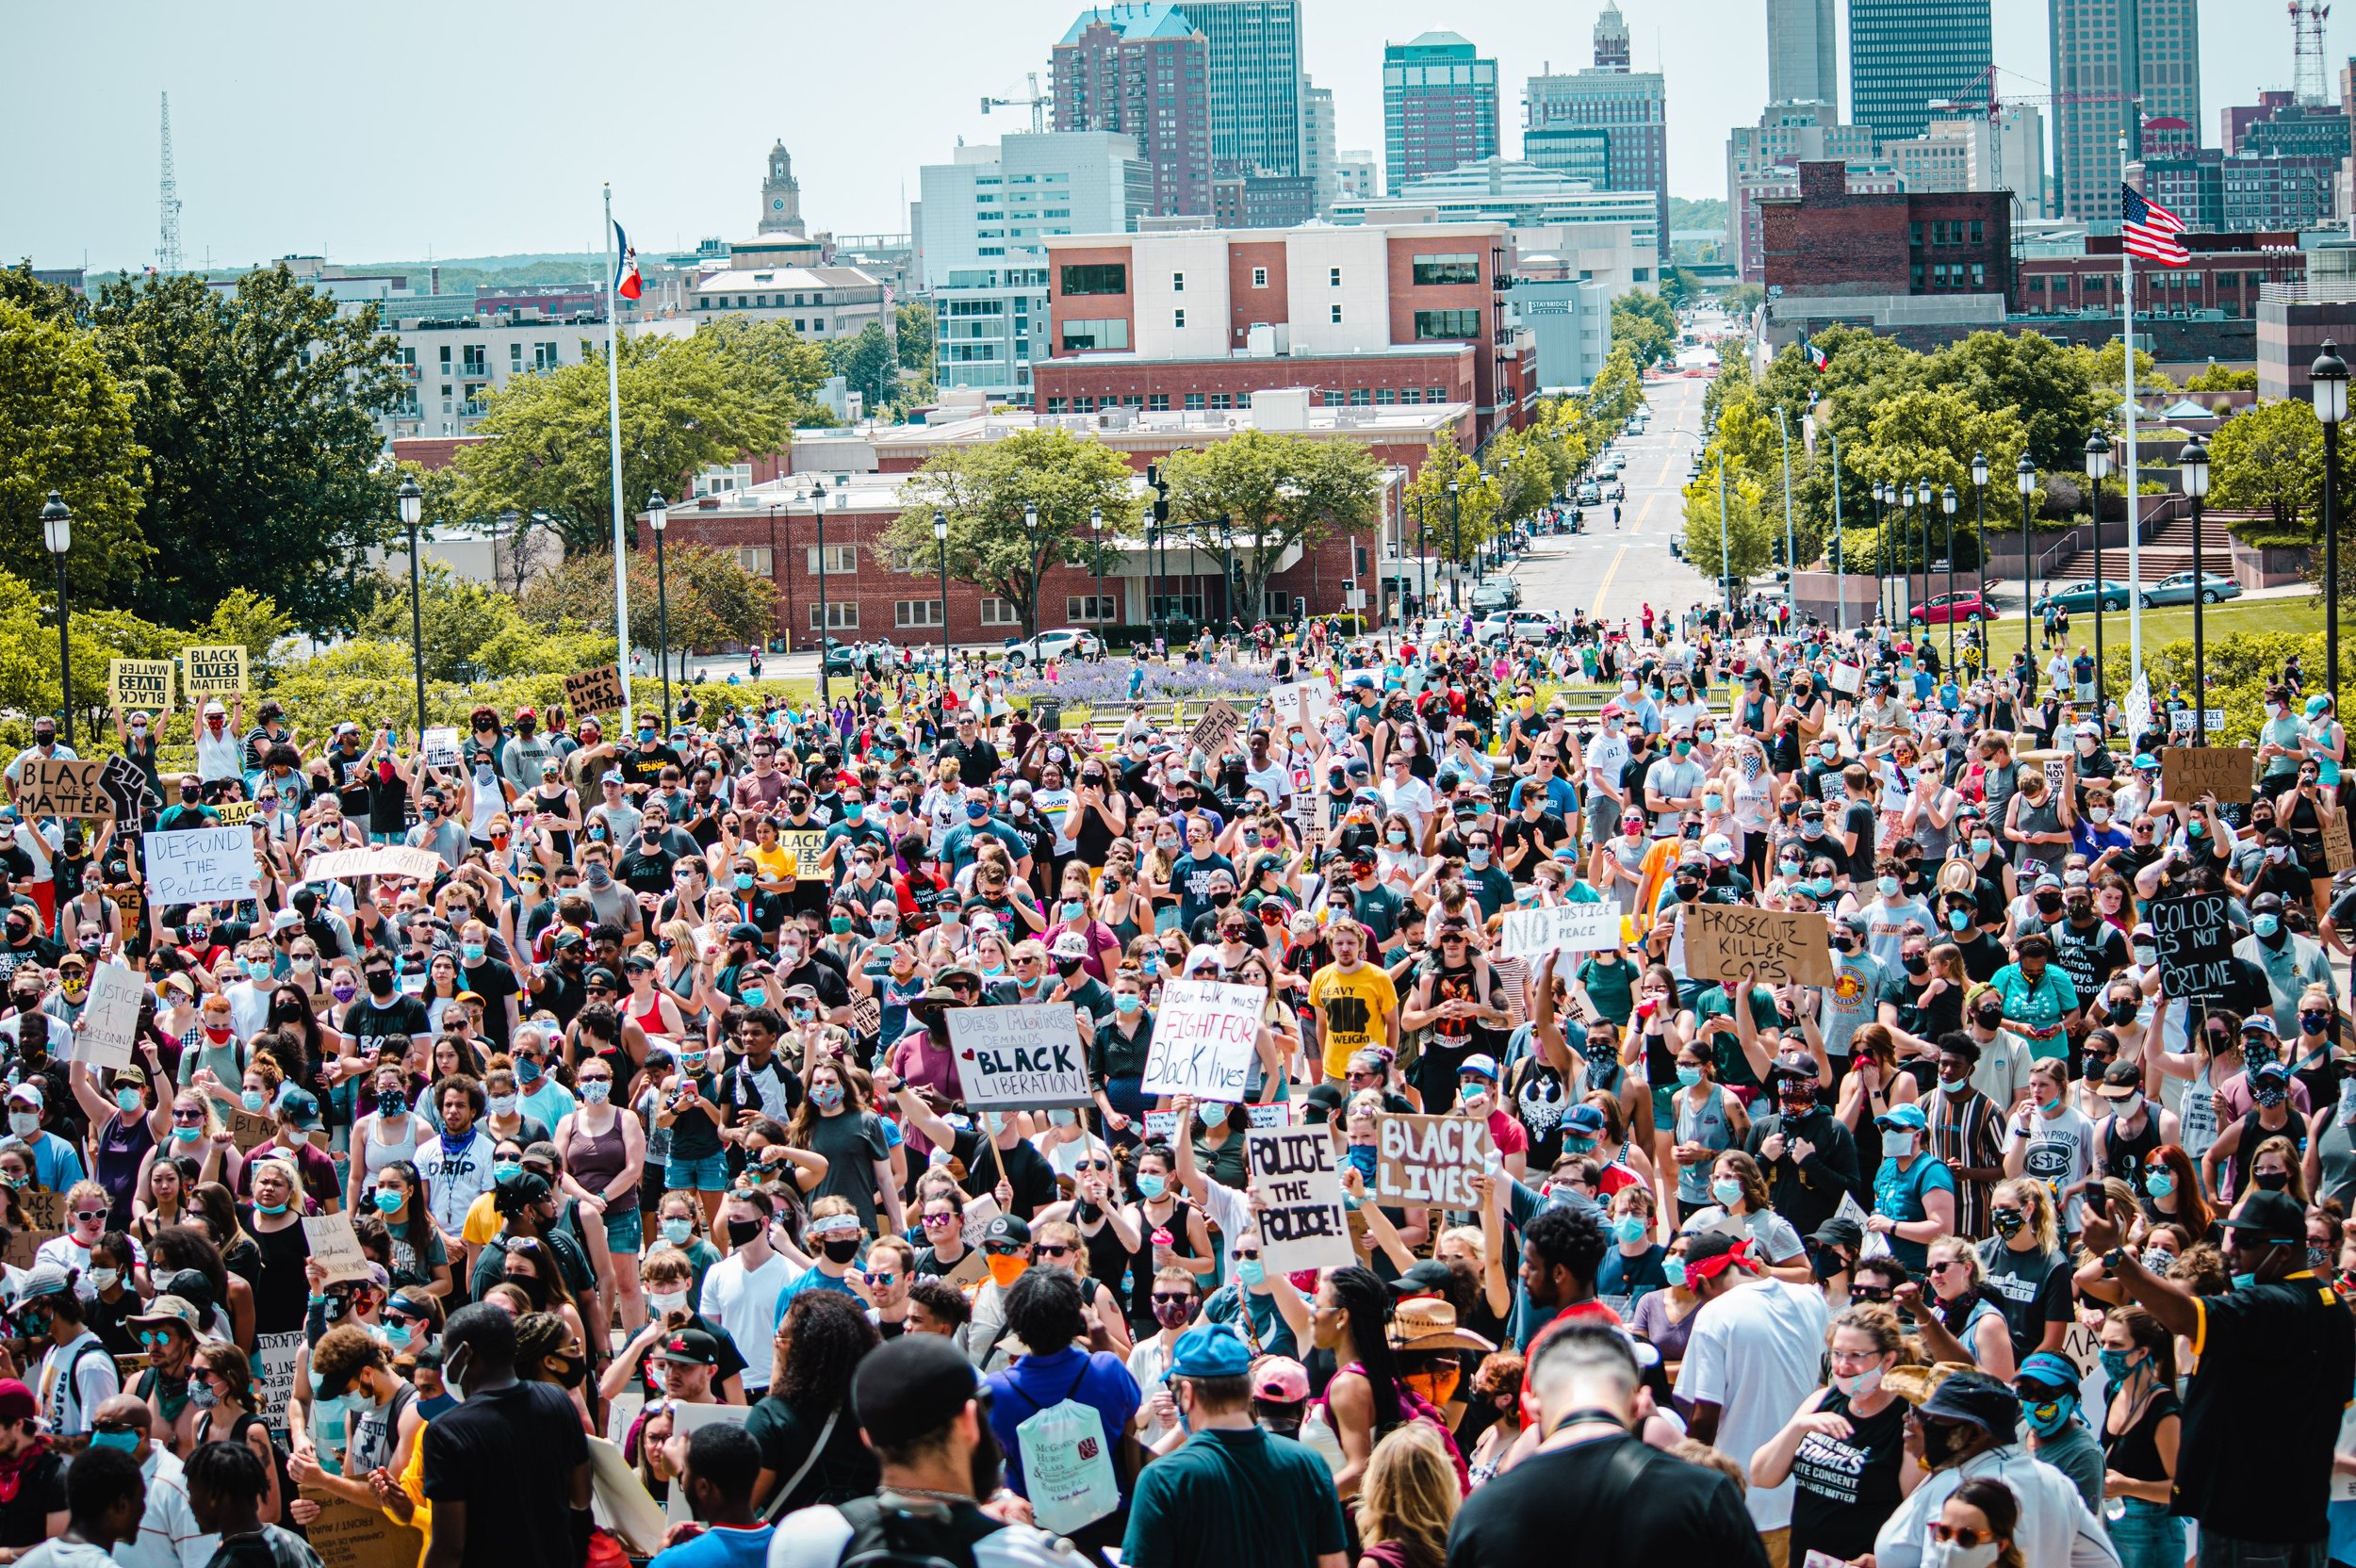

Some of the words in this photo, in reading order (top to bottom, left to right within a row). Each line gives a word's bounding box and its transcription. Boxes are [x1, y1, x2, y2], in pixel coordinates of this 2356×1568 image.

[191, 650, 237, 662] BLACK
[120, 663, 168, 675] MATTER
[193, 664, 237, 678] LIVES
[121, 677, 166, 690] LIVES
[190, 678, 238, 691] MATTER
[566, 669, 613, 693] BLACK
[119, 691, 166, 704] BLACK
[570, 683, 614, 706] LIVES
[574, 694, 627, 717] MATTER
[2190, 710, 2220, 720] JTICE
[427, 741, 446, 753] LIVES
[427, 751, 456, 766] MATTER
[2182, 750, 2239, 770] BLACK
[2179, 770, 2232, 785] LIVES
[42, 784, 92, 796] LIVES
[2174, 785, 2242, 800] MATTER
[20, 792, 110, 814] MATTER
[1297, 796, 1317, 811] BLACK
[117, 820, 139, 833] BLM
[155, 831, 243, 860] DEFUND
[2323, 835, 2348, 850] LIVES
[183, 859, 217, 874] THE
[309, 858, 324, 876] I
[378, 849, 436, 873] BREATHE
[2327, 853, 2354, 872] MATTER
[1191, 871, 1209, 879] THE
[1190, 886, 1210, 894] WAY
[1557, 905, 1611, 922] JUSTICE
[2152, 896, 2225, 934] COLOR
[1510, 913, 1550, 952] NO
[1559, 924, 1596, 939] PEACE
[1701, 908, 1808, 945] PROSECUTE
[1720, 940, 1797, 959] KILLER
[2154, 934, 2180, 956] IS
[2193, 927, 2221, 948] NOT
[0, 950, 37, 959] AMERICA
[2160, 956, 2174, 972] A
[1721, 960, 1786, 978] COPS
[2162, 960, 2235, 996] CRIME
[90, 982, 141, 1005] JUSTICE
[1164, 982, 1194, 1004] Brown
[1231, 994, 1263, 1014] must
[1319, 987, 1355, 997] HEAVY
[98, 1003, 111, 1026] 4
[854, 1001, 876, 1022] LIVES
[956, 1012, 999, 1034] DES
[1165, 1010, 1221, 1038] FIGHT
[1219, 1014, 1256, 1043] FOR
[79, 1025, 132, 1046] BREONNA
[983, 1033, 1043, 1047] DEMANDS
[1333, 1034, 1370, 1044] WEIGHT
[976, 1044, 1076, 1076] BLACK
[1208, 1046, 1245, 1088] lives
[974, 1069, 1088, 1098] LIBERATION!
[1382, 1118, 1485, 1166] BLACK
[2051, 1130, 2080, 1147] PROUD
[1251, 1134, 1334, 1177] POLICE
[429, 1160, 476, 1177] DRIP
[1269, 1180, 1311, 1201] THE
[1380, 1164, 1480, 1208] LIVES
[1257, 1205, 1343, 1246] POLICE!
[1794, 1437, 1865, 1475] EQUALS
[1812, 1467, 1859, 1489] CONSENT
[1807, 1482, 1825, 1494] LIVES
[1824, 1487, 1857, 1504] MATTER
[343, 1517, 374, 1530] FRONT
